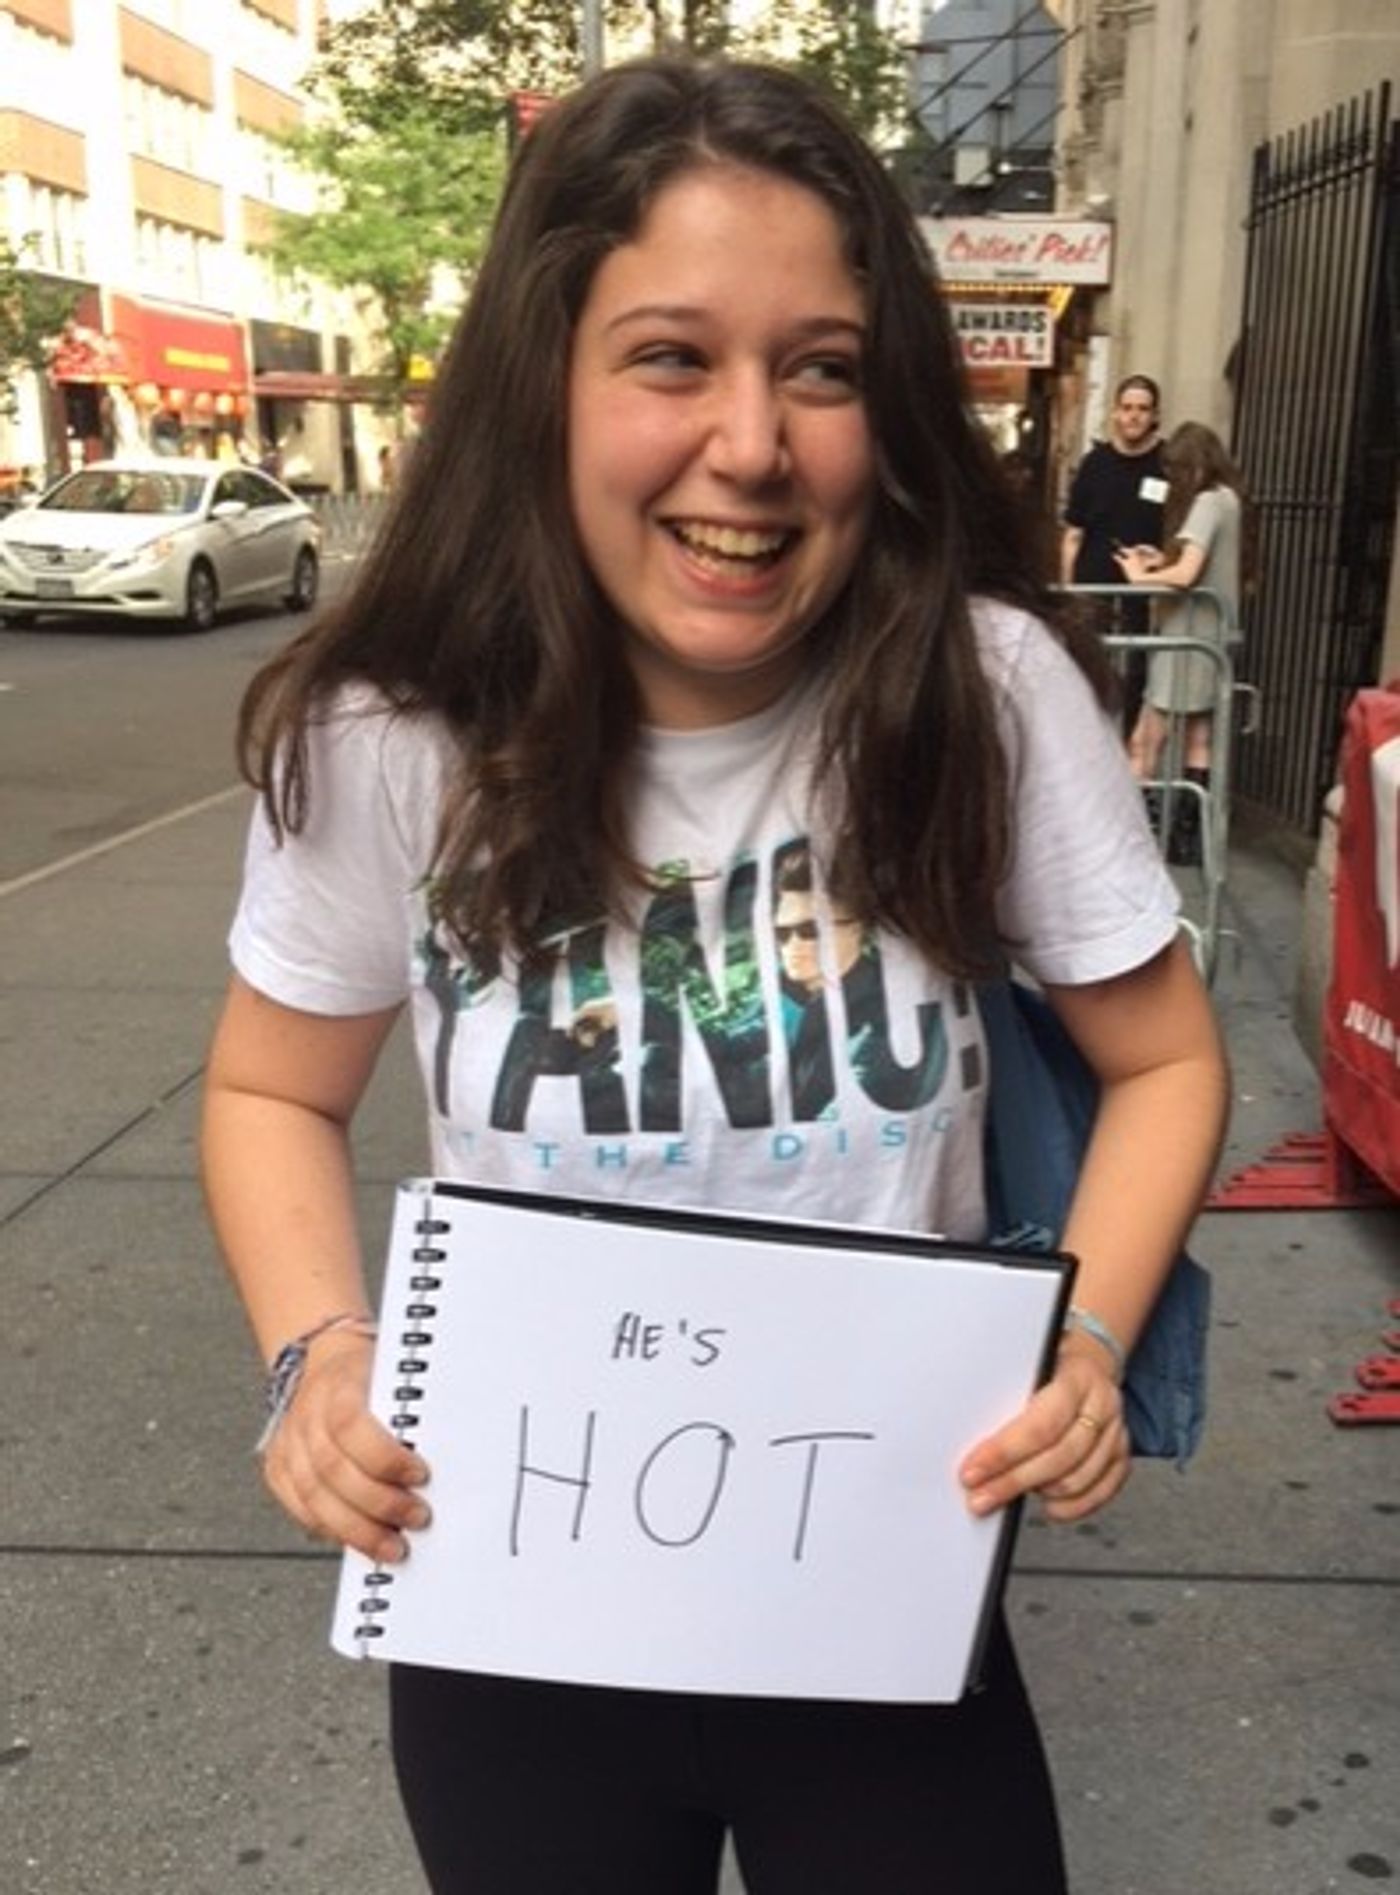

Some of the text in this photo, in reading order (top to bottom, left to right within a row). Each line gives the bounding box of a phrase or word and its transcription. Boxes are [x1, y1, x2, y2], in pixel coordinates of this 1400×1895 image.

[957, 310, 1047, 333] AWARDS
[533, 1141, 690, 1170] THE
[610, 1311, 728, 1367] HE'S
[508, 1403, 877, 1564] HOT
